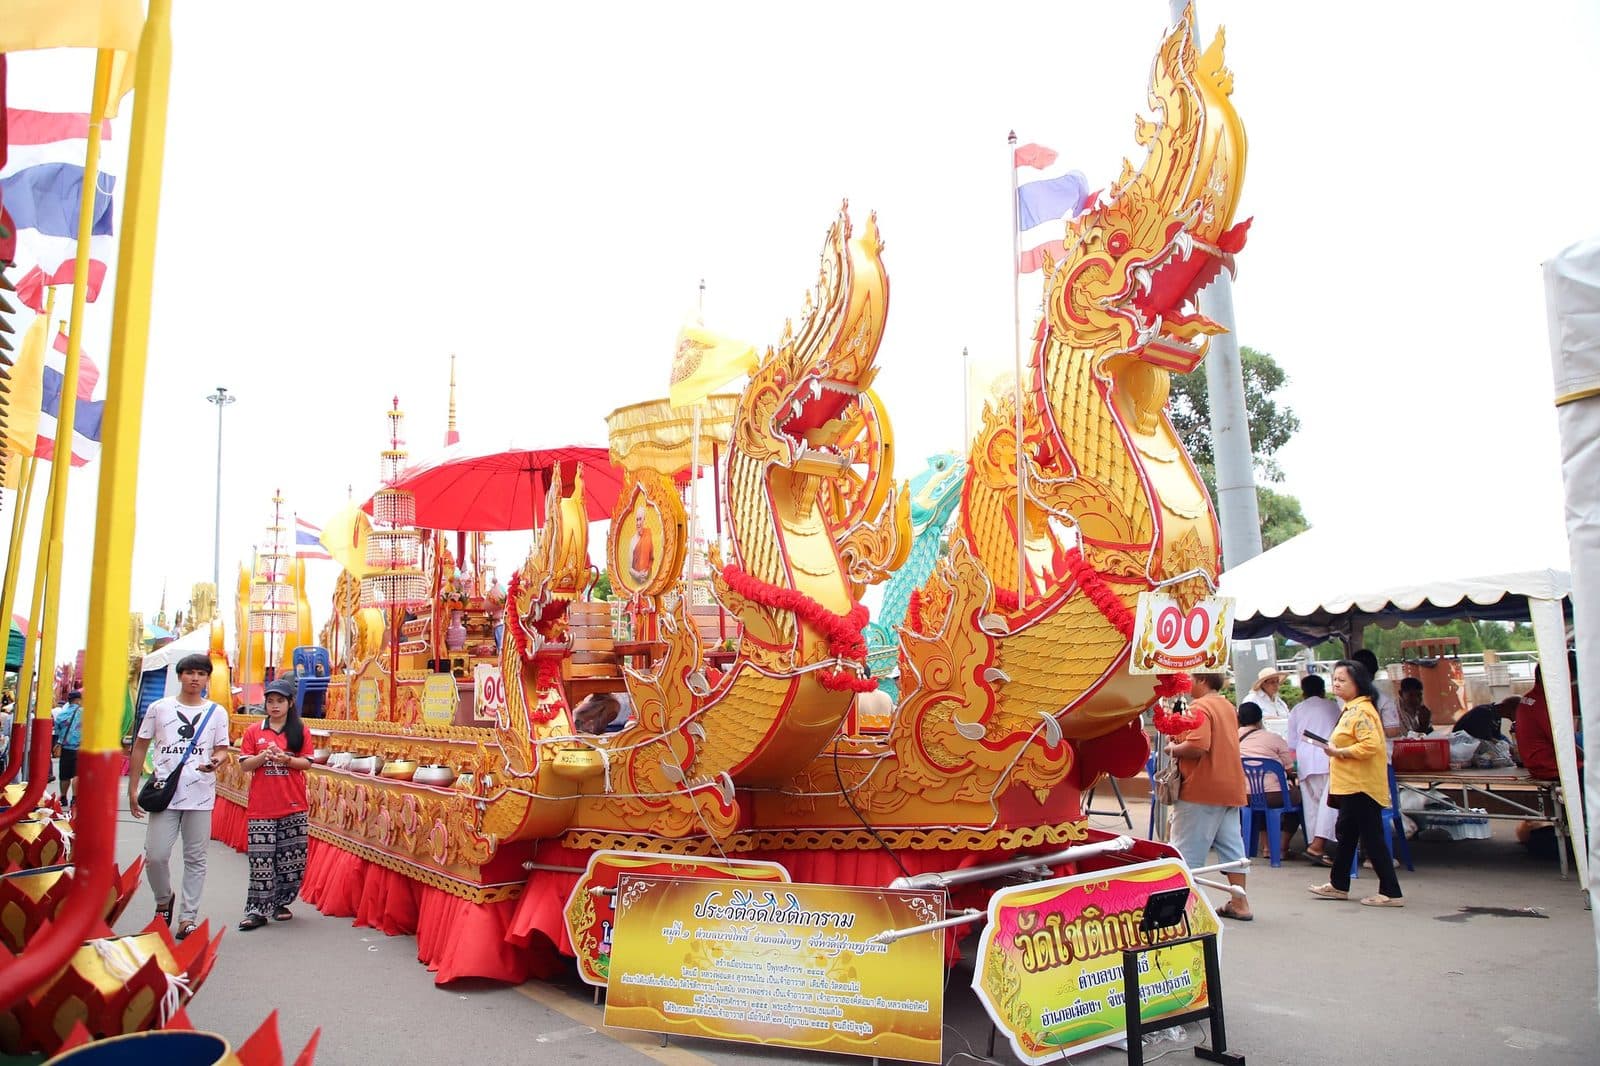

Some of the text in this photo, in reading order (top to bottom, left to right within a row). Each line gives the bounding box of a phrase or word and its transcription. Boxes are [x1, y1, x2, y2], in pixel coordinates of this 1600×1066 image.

[1157, 607, 1210, 649] ๑๐
[161, 746, 204, 756] PLAYOY
[1042, 1000, 1101, 1026] อำเภอเมืองฯ
